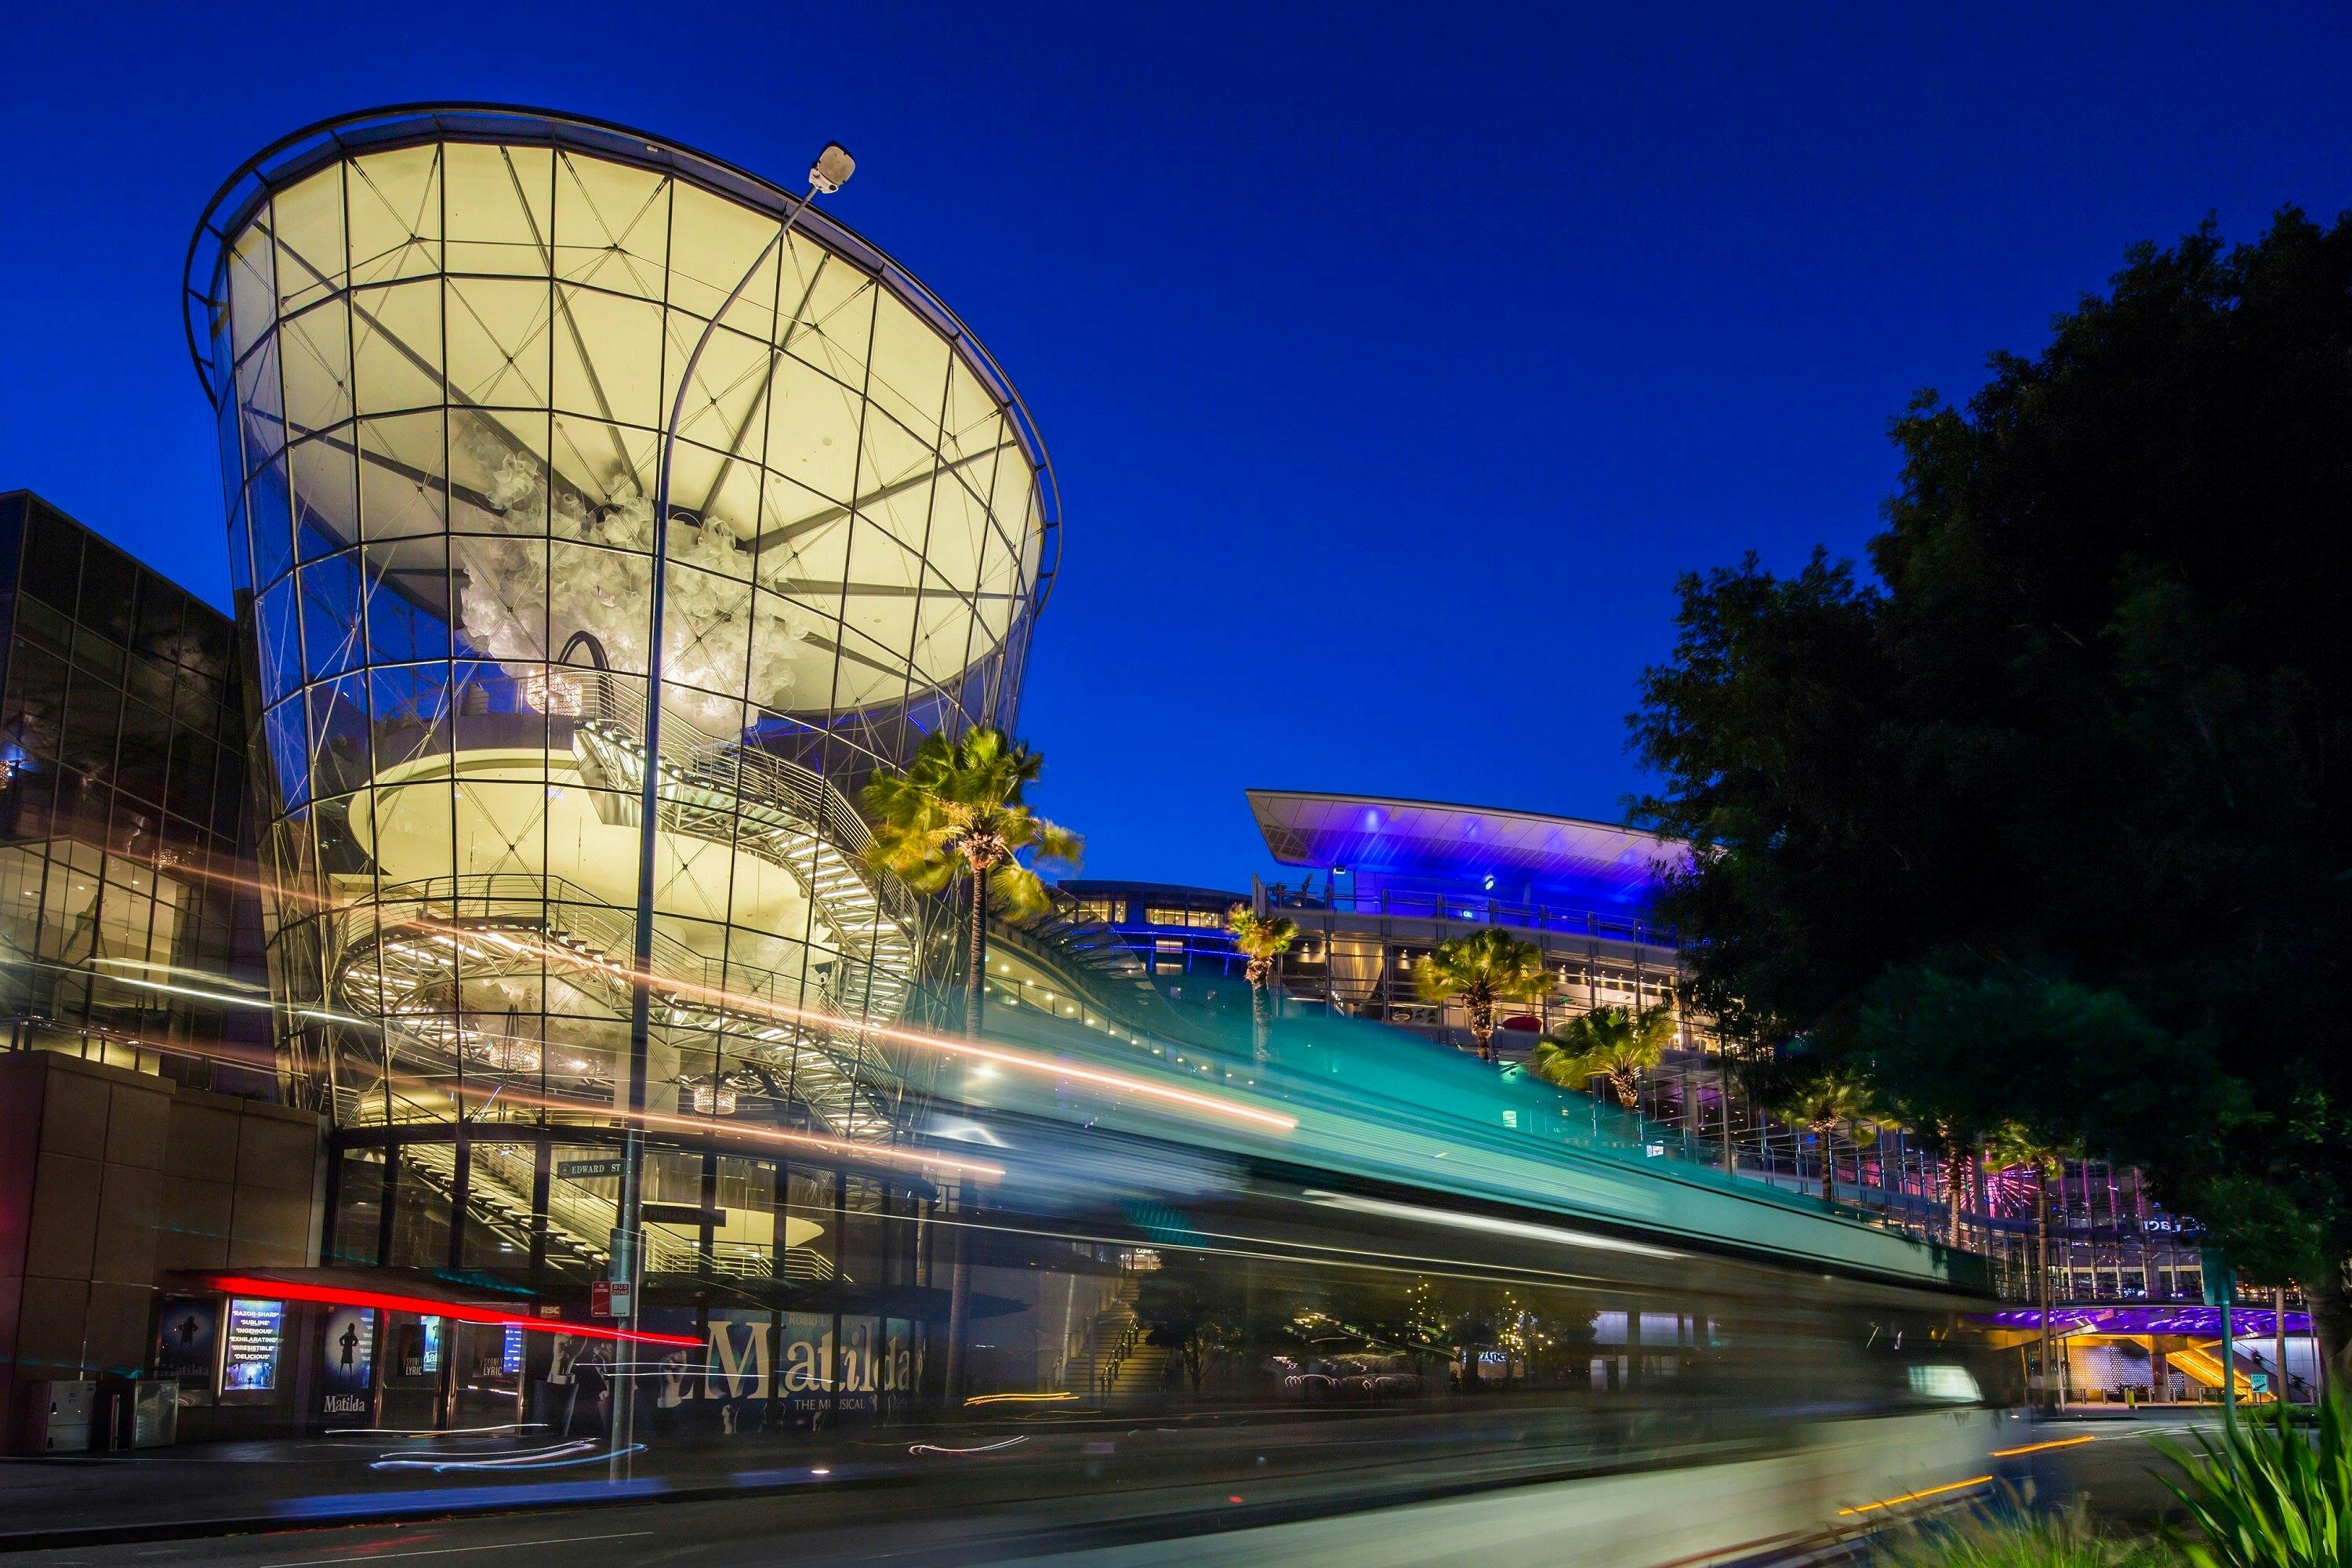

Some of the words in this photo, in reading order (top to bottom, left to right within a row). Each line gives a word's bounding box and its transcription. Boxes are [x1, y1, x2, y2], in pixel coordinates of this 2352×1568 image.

[572, 1164, 604, 1174] EDWARD
[611, 1163, 621, 1172] ST
[406, 1357, 423, 1367] SYDNEY
[484, 1357, 503, 1367] SYDNEY
[681, 1320, 910, 1399] Matilda
[405, 1366, 423, 1376] LYRIC
[484, 1366, 503, 1376] LYRIC
[323, 1394, 365, 1413] Matilda
[794, 1399, 815, 1410] THE
